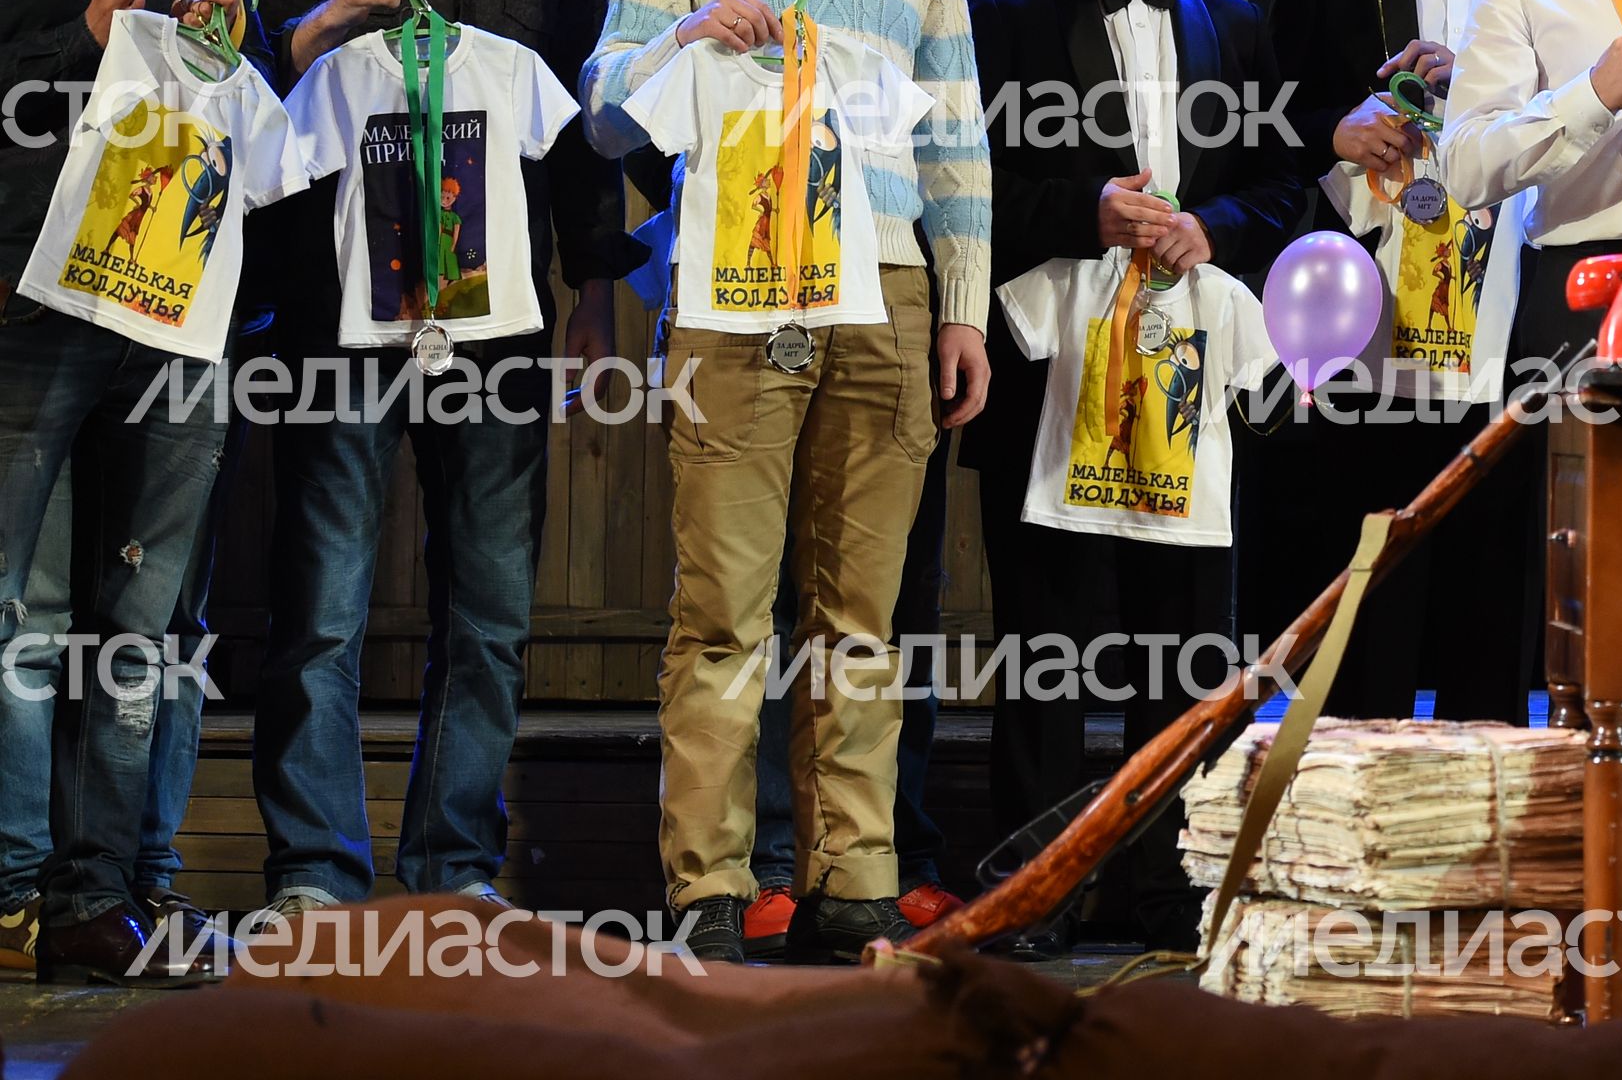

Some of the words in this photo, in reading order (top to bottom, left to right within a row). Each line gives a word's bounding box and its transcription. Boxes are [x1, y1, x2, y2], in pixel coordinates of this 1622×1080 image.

[363, 119, 481, 143] МАЛЕКИЙ
[365, 142, 447, 167] ПРИ
[71, 243, 194, 300] МАЛЕНЬКАЯ
[714, 262, 837, 284] МАЛЕНКАЯ
[63, 263, 186, 322] КОЛДУНЬЯ
[1071, 463, 1190, 491] МАЛЕНЬКАЯ
[1068, 483, 1187, 514] КОЛДУНЬЯ
